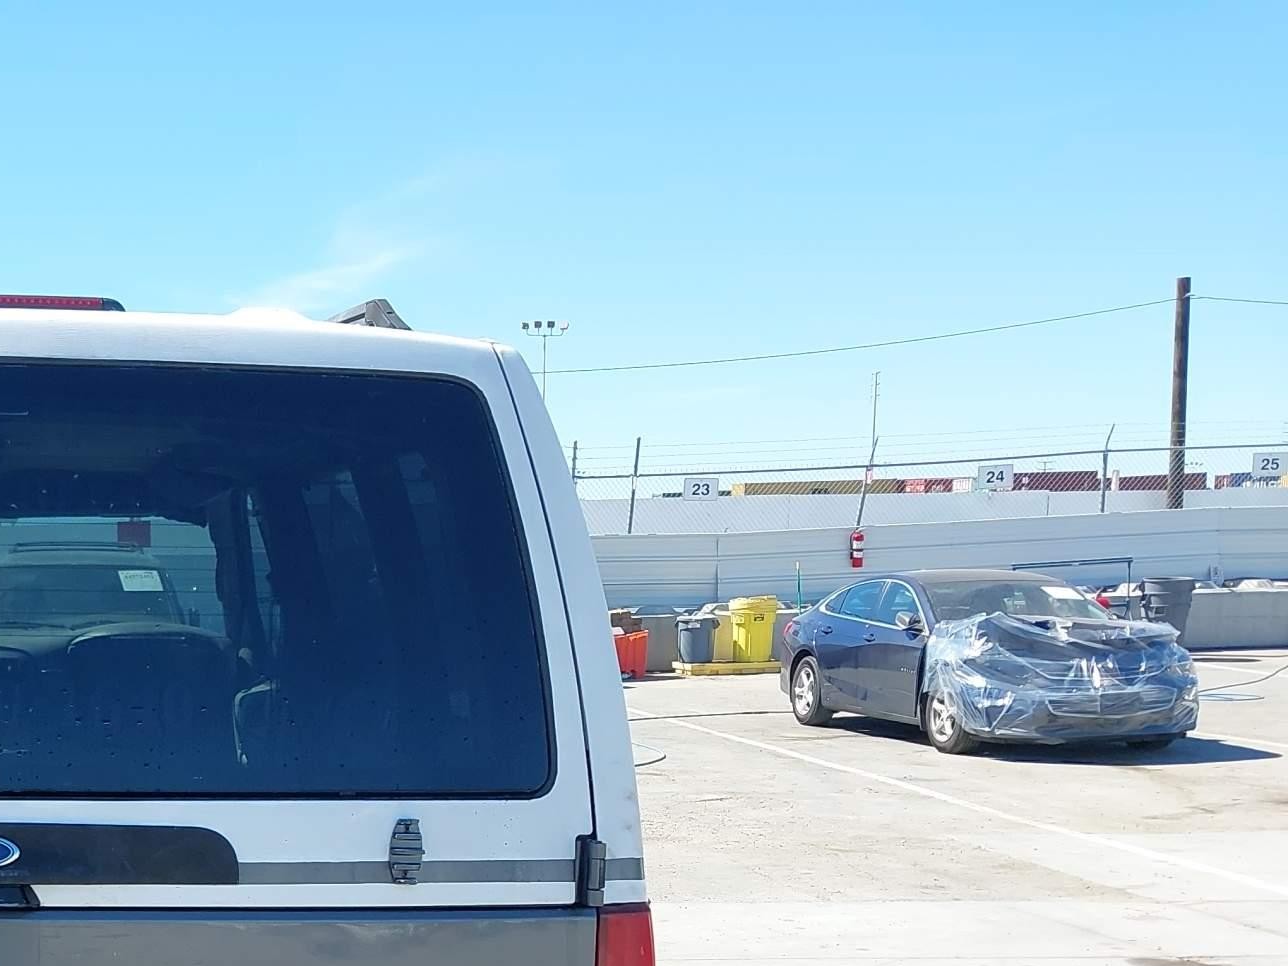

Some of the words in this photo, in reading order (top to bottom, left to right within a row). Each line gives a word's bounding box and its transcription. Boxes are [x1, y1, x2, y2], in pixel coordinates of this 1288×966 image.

[1261, 458, 1279, 470] 25
[986, 470, 1005, 483] 24
[692, 483, 710, 495] 23
